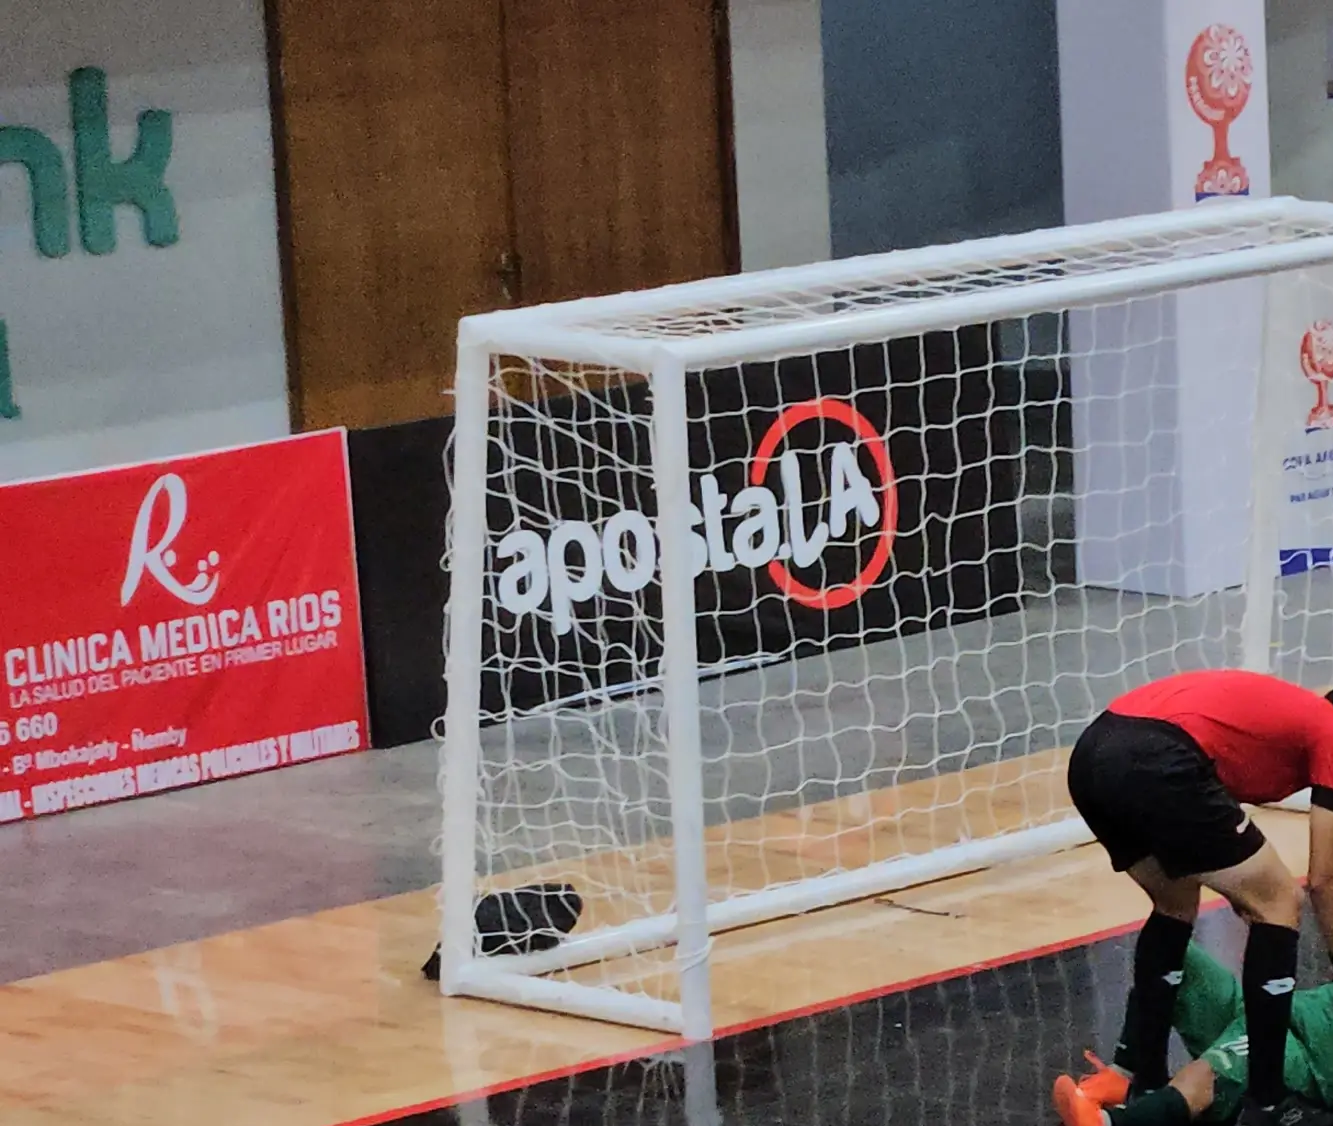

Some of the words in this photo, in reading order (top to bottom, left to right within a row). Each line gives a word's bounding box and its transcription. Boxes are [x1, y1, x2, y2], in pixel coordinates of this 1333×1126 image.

[5, 629, 132, 687] CLINICA
[139, 606, 261, 662] MEDICA
[267, 589, 342, 638] RIOS
[9, 688, 31, 709] LA
[32, 678, 85, 705] SALUD
[88, 672, 119, 694] DEL
[121, 656, 198, 687] PACIENTE
[200, 651, 222, 674] EN
[225, 640, 282, 668] PRIMER
[285, 630, 337, 656] LUGAR
[15, 712, 58, 742] 660
